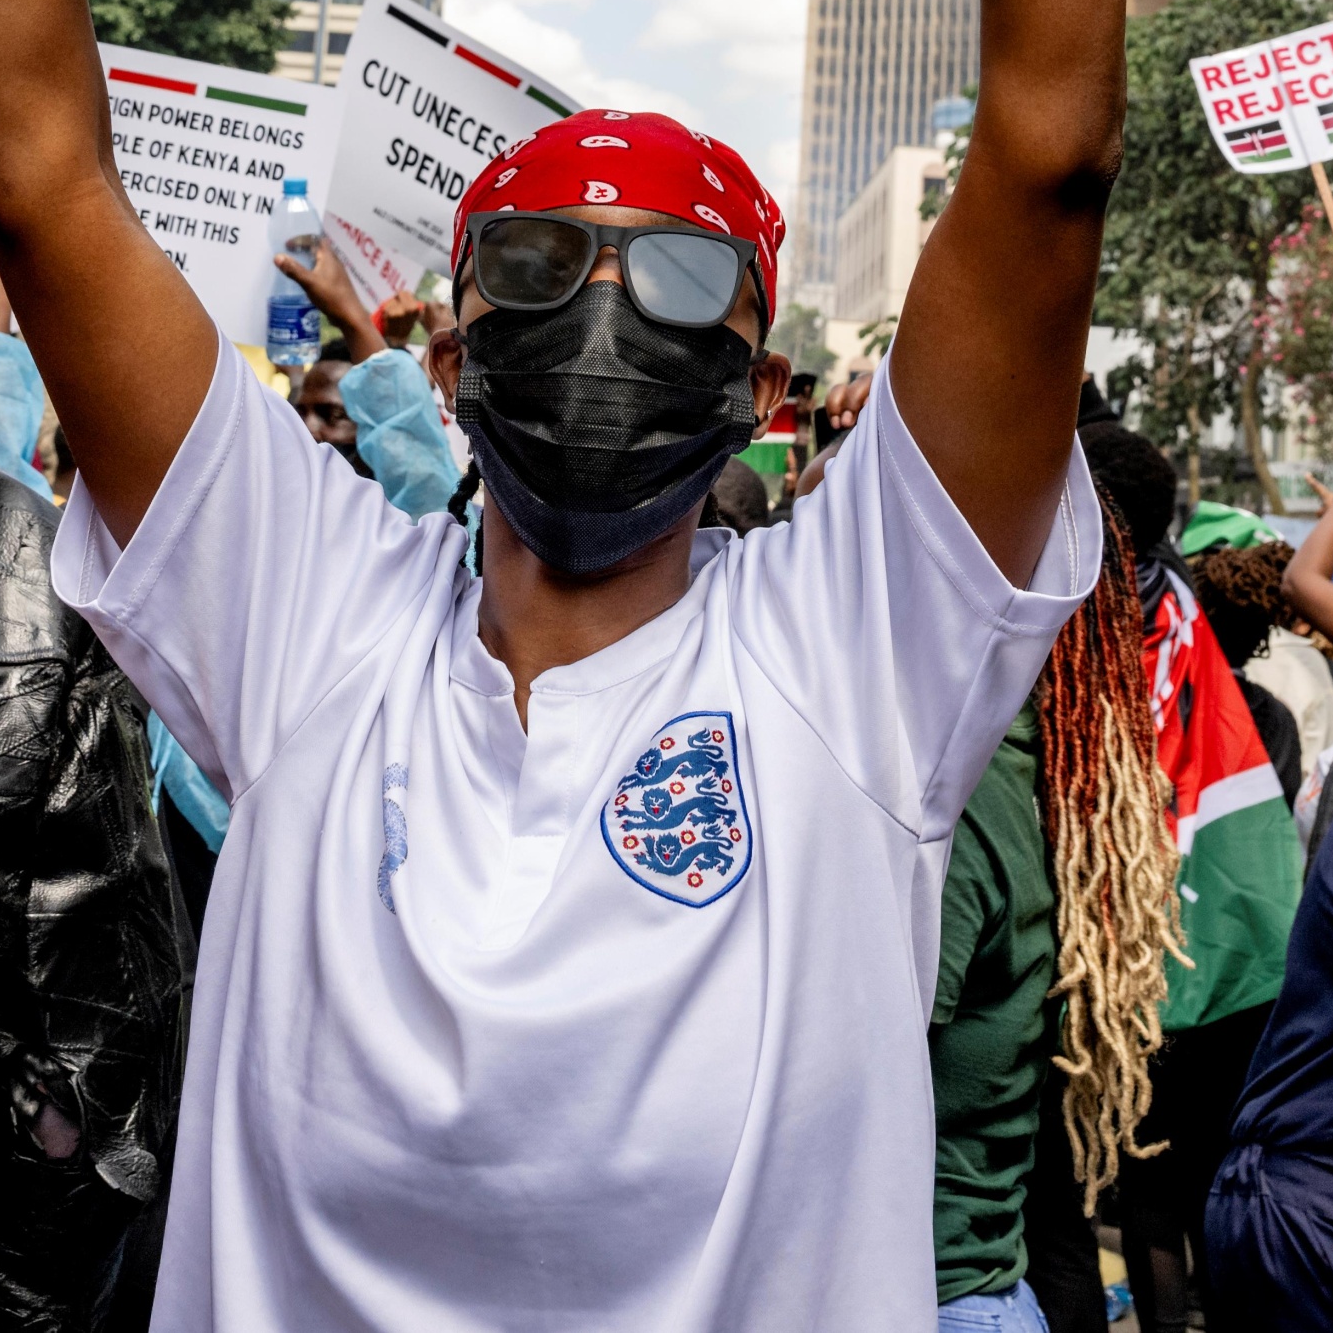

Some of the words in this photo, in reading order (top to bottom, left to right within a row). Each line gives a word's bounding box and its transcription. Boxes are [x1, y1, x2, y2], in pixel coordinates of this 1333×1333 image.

[362, 59, 411, 105] CUT
[147, 104, 214, 133] POWER
[218, 117, 305, 150] BELONGS
[148, 140, 174, 161] OF
[177, 145, 239, 175] KENYA
[245, 158, 285, 182] AND
[204, 186, 252, 212] ONLY
[255, 196, 275, 217] IN
[154, 212, 198, 238] WITH
[202, 220, 240, 245] THIS
